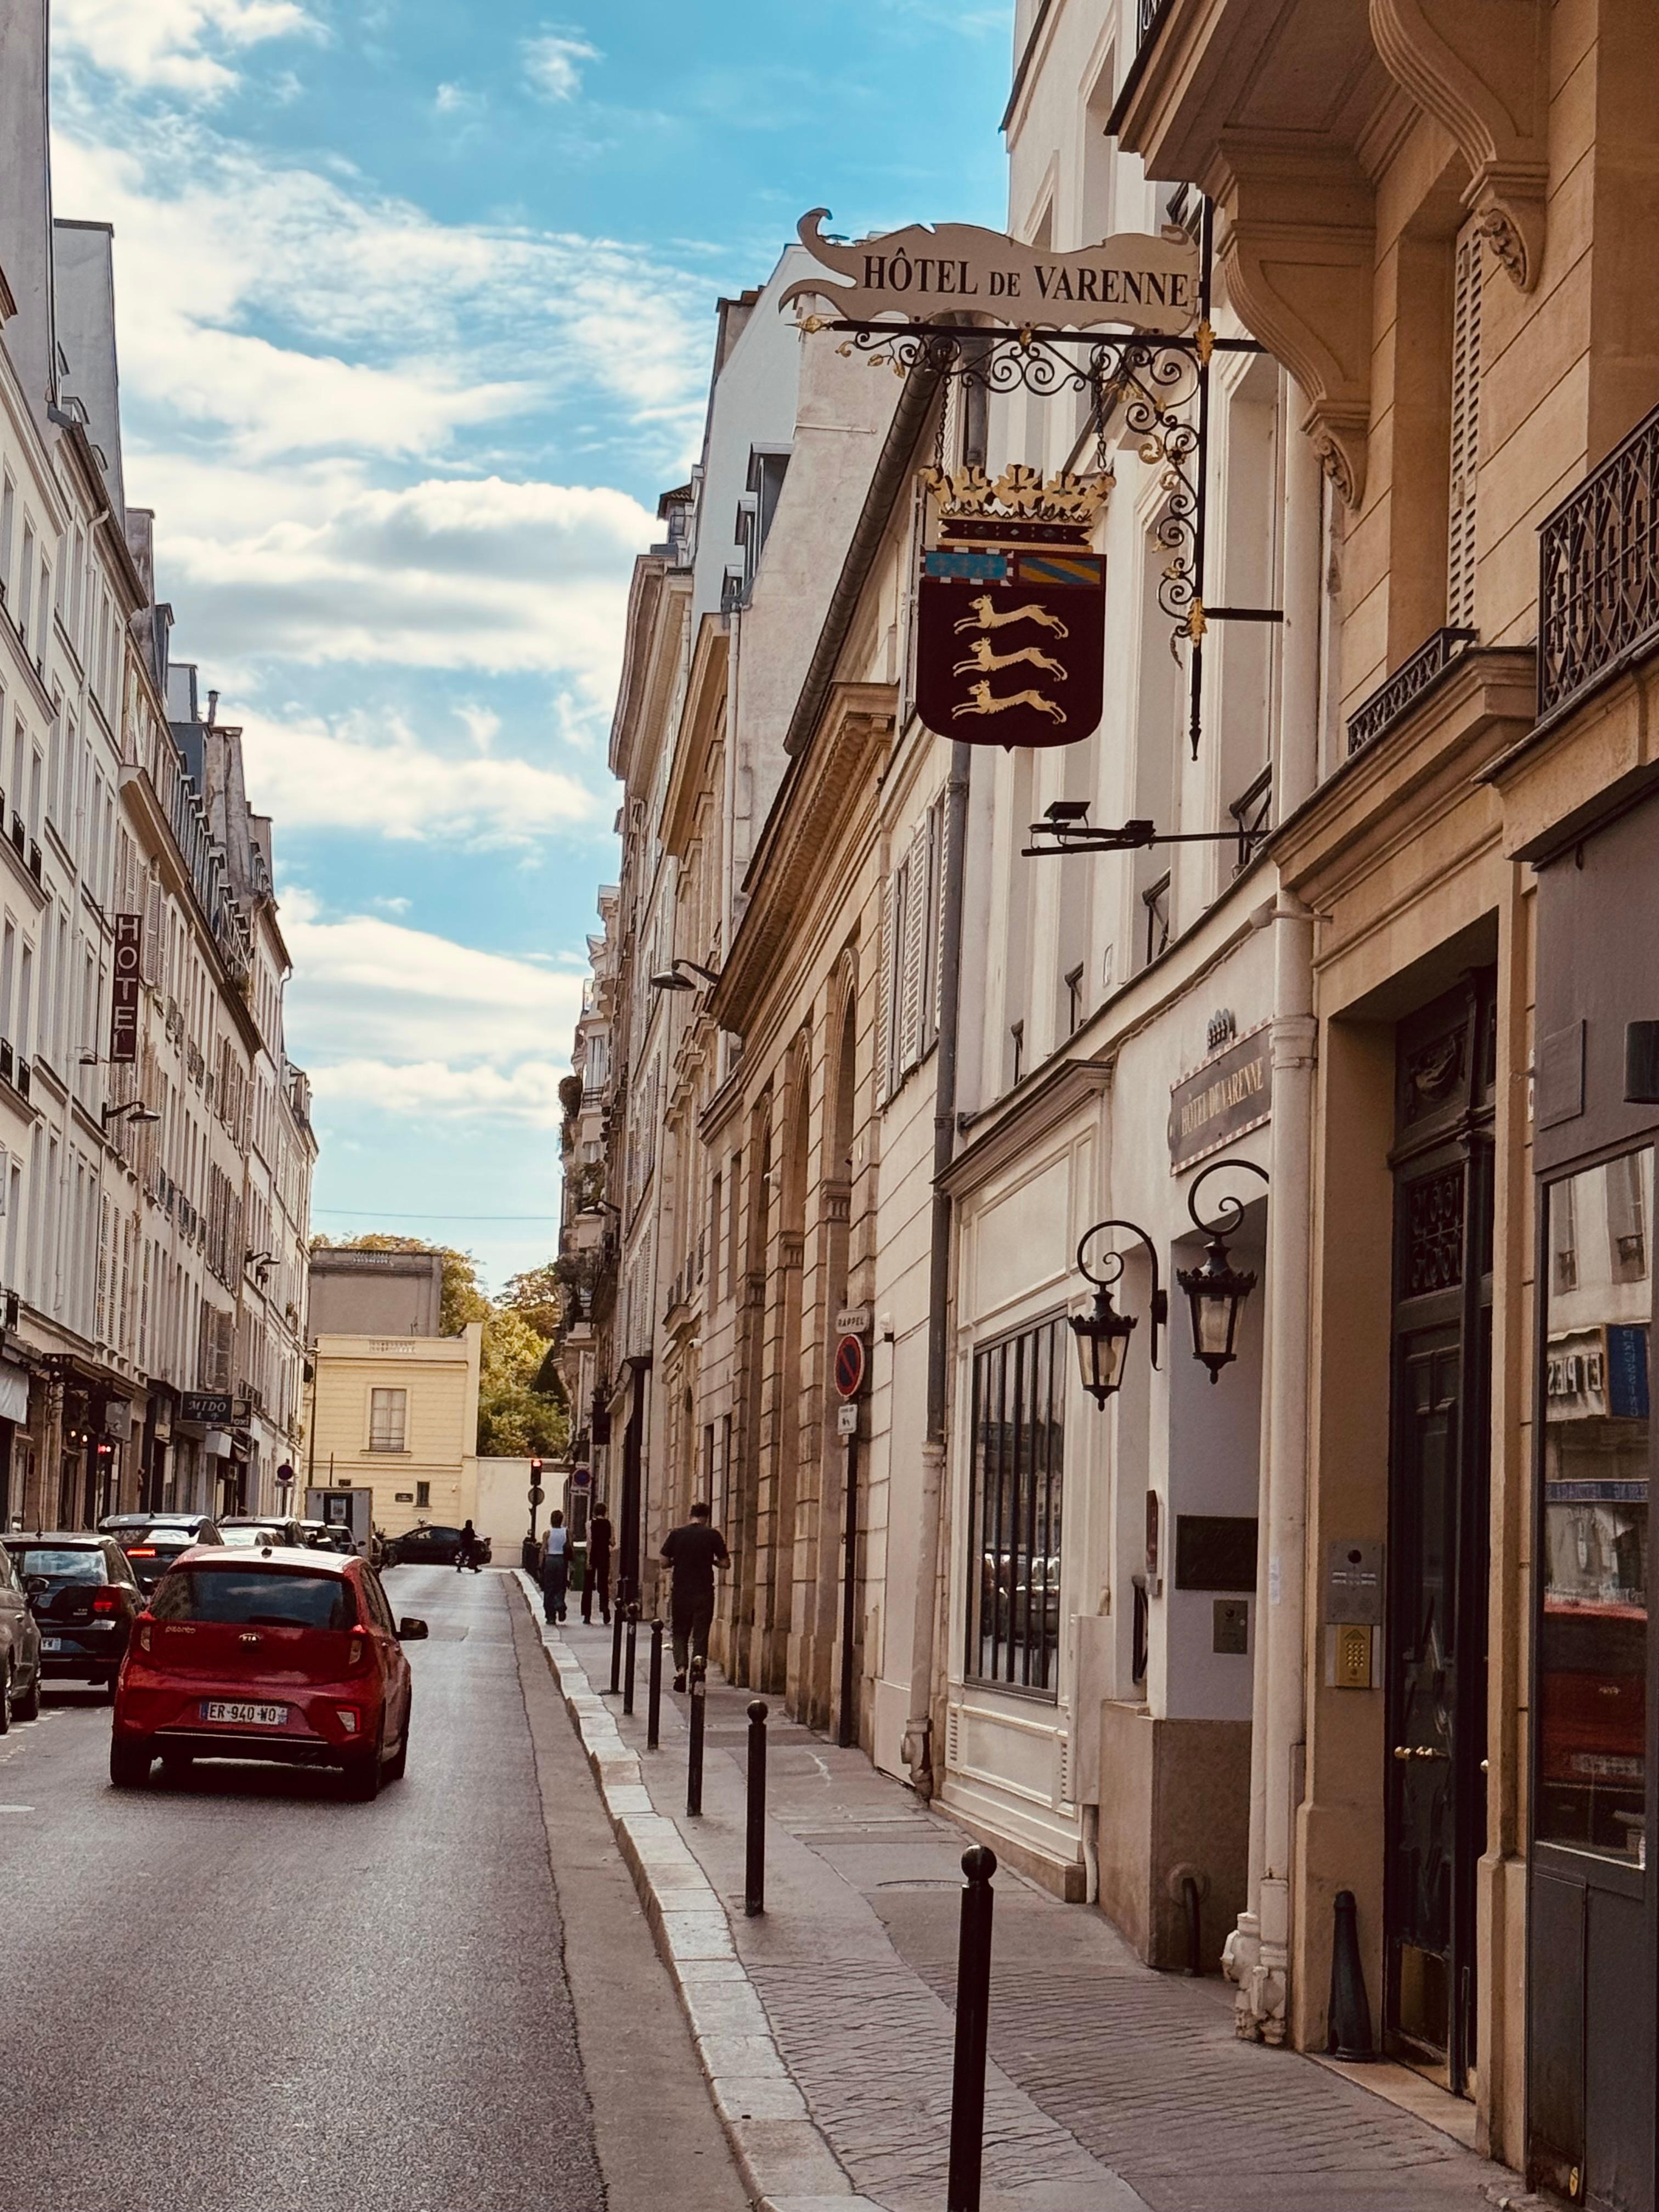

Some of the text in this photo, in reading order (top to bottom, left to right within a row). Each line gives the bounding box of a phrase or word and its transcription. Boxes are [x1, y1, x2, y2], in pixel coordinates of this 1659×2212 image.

[862, 247, 1189, 308] HÔTEL DE VARENNE
[112, 917, 139, 1058] HOTEL
[838, 1318, 865, 1327] RAPPEL
[188, 1400, 227, 1413] MIDO
